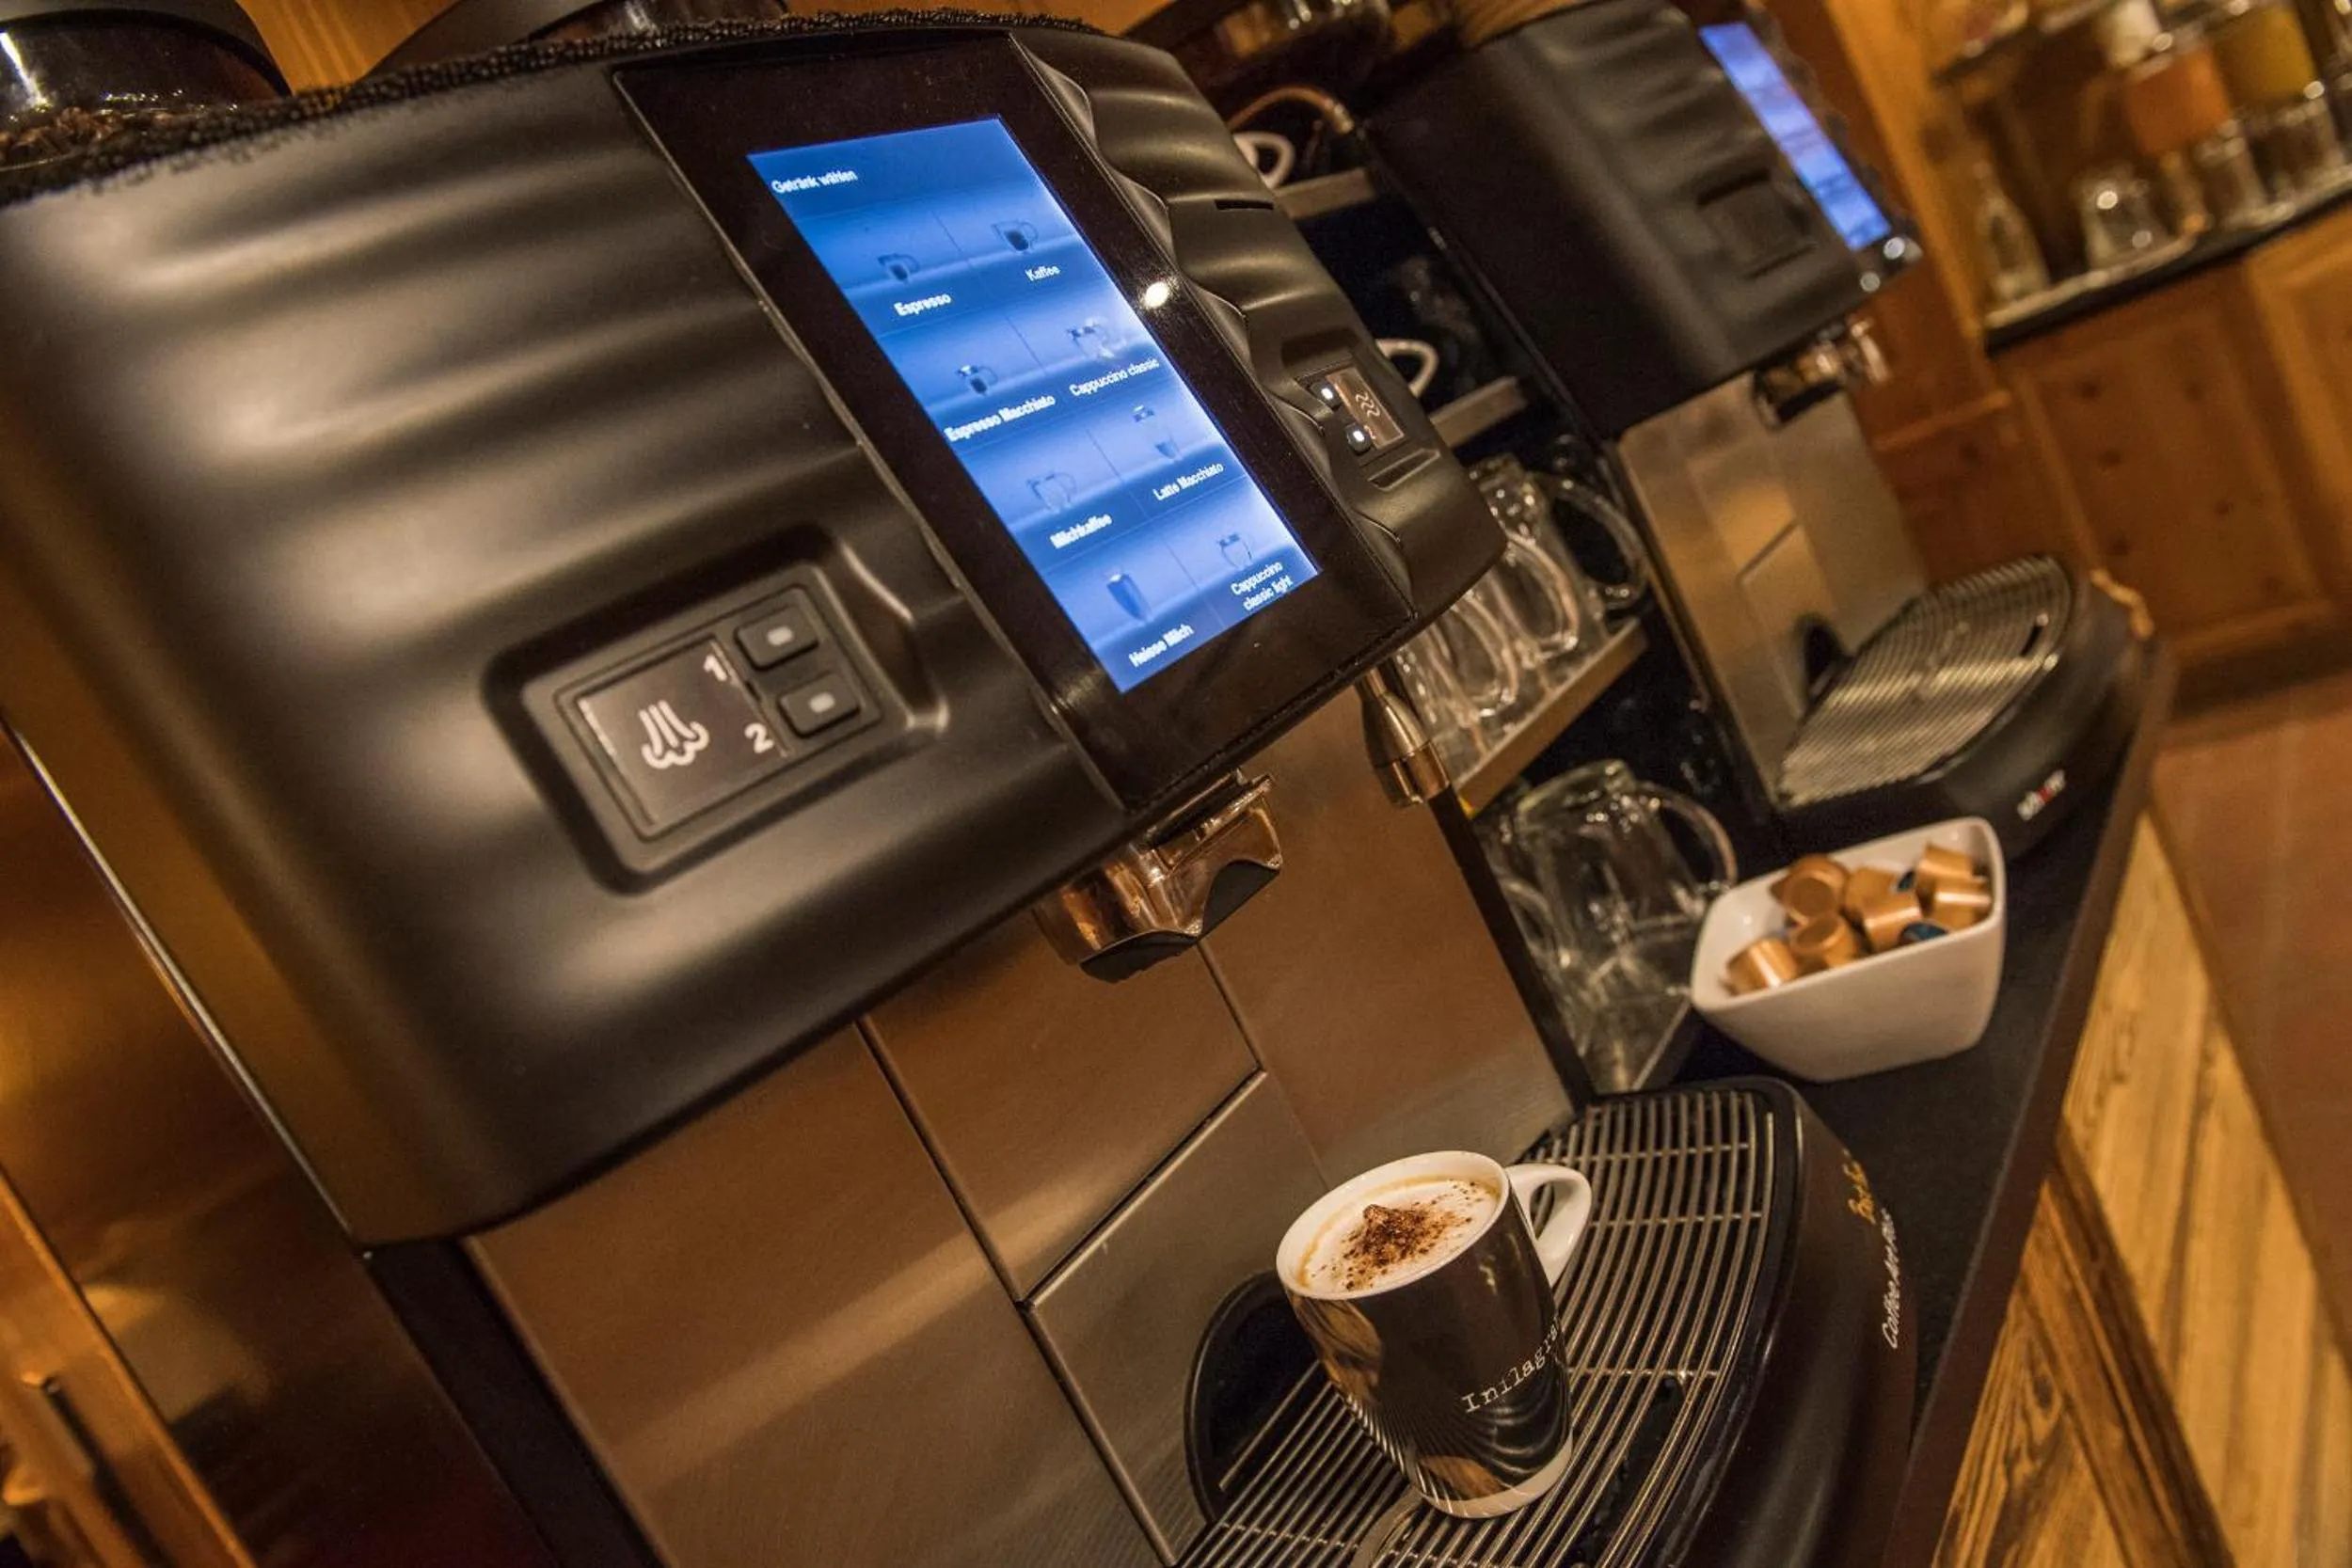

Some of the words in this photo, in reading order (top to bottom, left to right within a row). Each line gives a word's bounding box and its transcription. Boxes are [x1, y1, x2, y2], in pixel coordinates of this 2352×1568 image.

[1025, 265, 1060, 282] Kaffee
[894, 293, 952, 316] Espresso
[1069, 371, 1129, 396] Cappuccino
[1127, 357, 1160, 376] classic
[944, 414, 1002, 442] Espresso
[998, 394, 1057, 422] Macchiato
[1152, 480, 1180, 500] Latte
[1176, 463, 1224, 489] Macchiato
[1049, 514, 1113, 549] Milchkaffee
[1231, 562, 1283, 595] Cappuccino
[1243, 587, 1274, 610] classic
[1271, 575, 1295, 594] light
[1162, 624, 1195, 647] Milch
[704, 655, 728, 682] 1
[744, 723, 774, 752] 2
